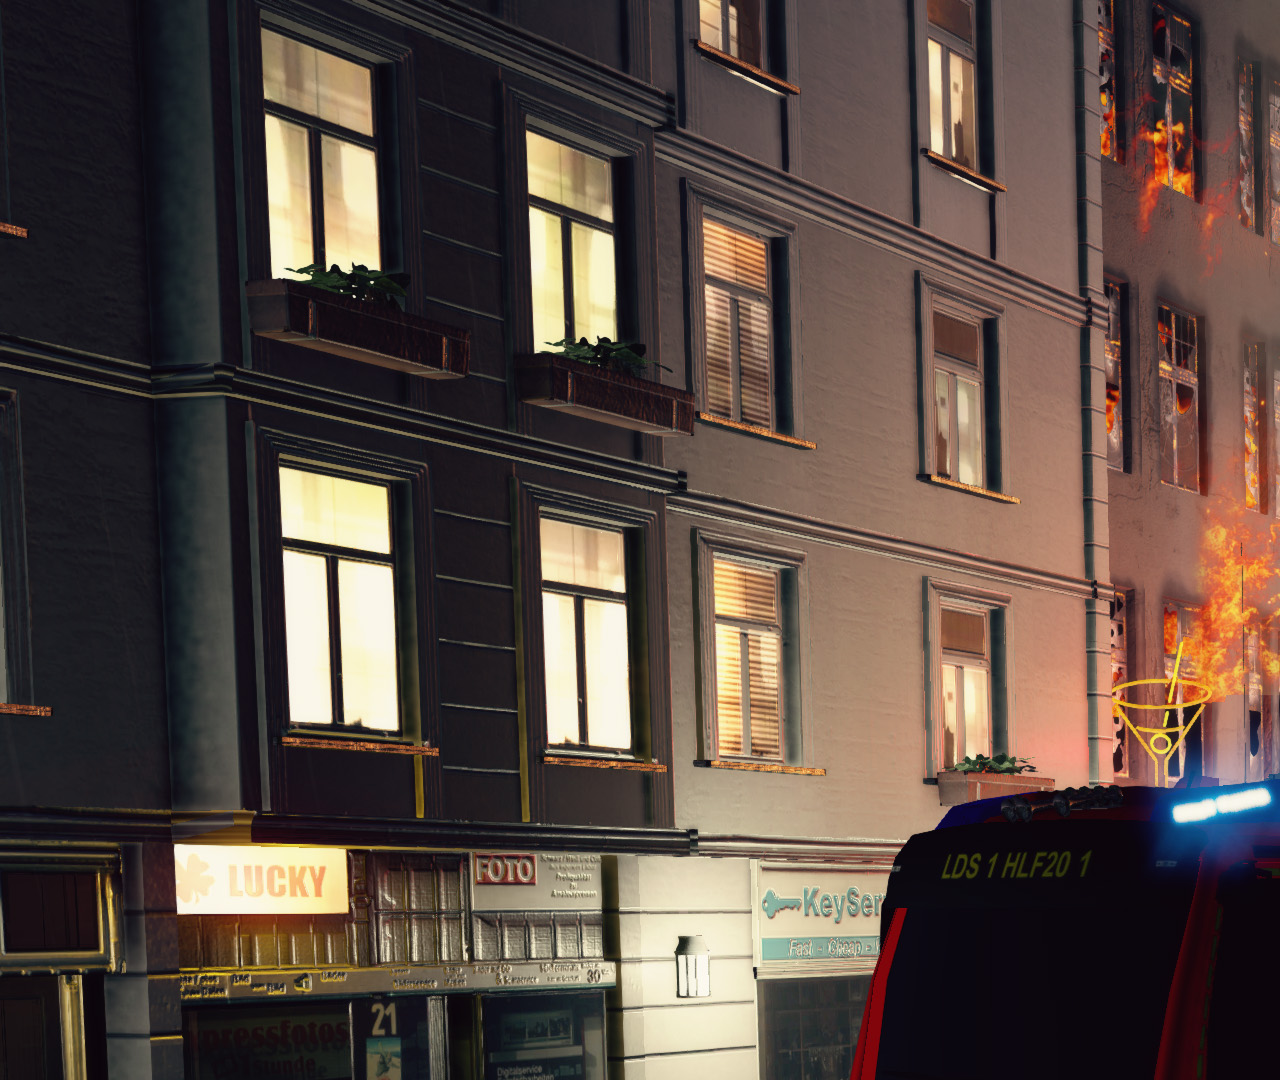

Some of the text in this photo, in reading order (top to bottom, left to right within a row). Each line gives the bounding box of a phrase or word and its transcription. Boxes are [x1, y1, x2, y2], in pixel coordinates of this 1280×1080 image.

[476, 856, 534, 883] FOTO
[941, 849, 1093, 880] LDS 1 HLF20 1
[228, 865, 327, 897] LUCKY
[803, 886, 885, 925] KeySer
[789, 937, 863, 958] Fast Cheap
[587, 969, 601, 984] 30
[371, 1002, 397, 1036] 21
[200, 1019, 349, 1053] pressfotos
[497, 1065, 542, 1078] Digitalservice
